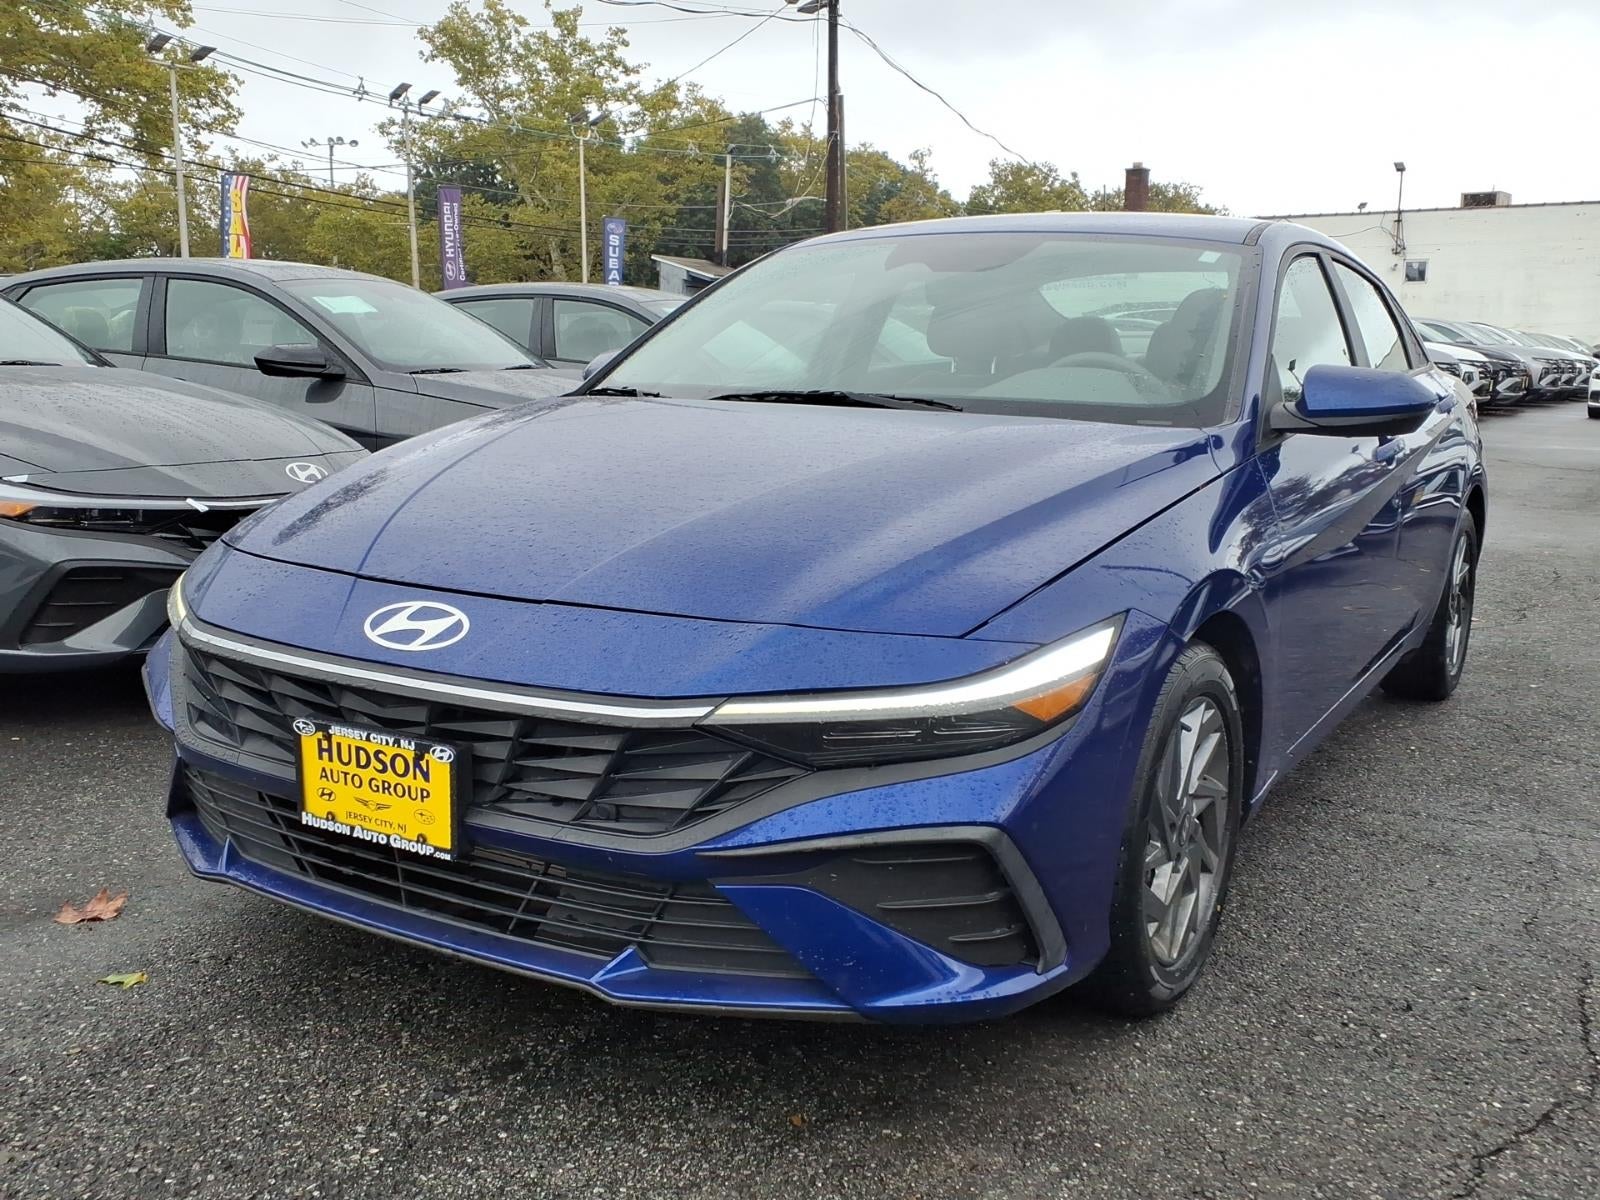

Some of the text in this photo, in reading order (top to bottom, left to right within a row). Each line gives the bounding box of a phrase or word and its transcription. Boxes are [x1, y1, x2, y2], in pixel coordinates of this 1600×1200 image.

[443, 202, 455, 257] HYUNDAI
[328, 725, 415, 751] JERSEY CITY, NJ
[316, 738, 431, 784] HUDSON
[319, 767, 431, 803] AUTO GROUP
[345, 811, 408, 833] JERSEY CITY, NJ
[352, 825, 388, 844] AUTO
